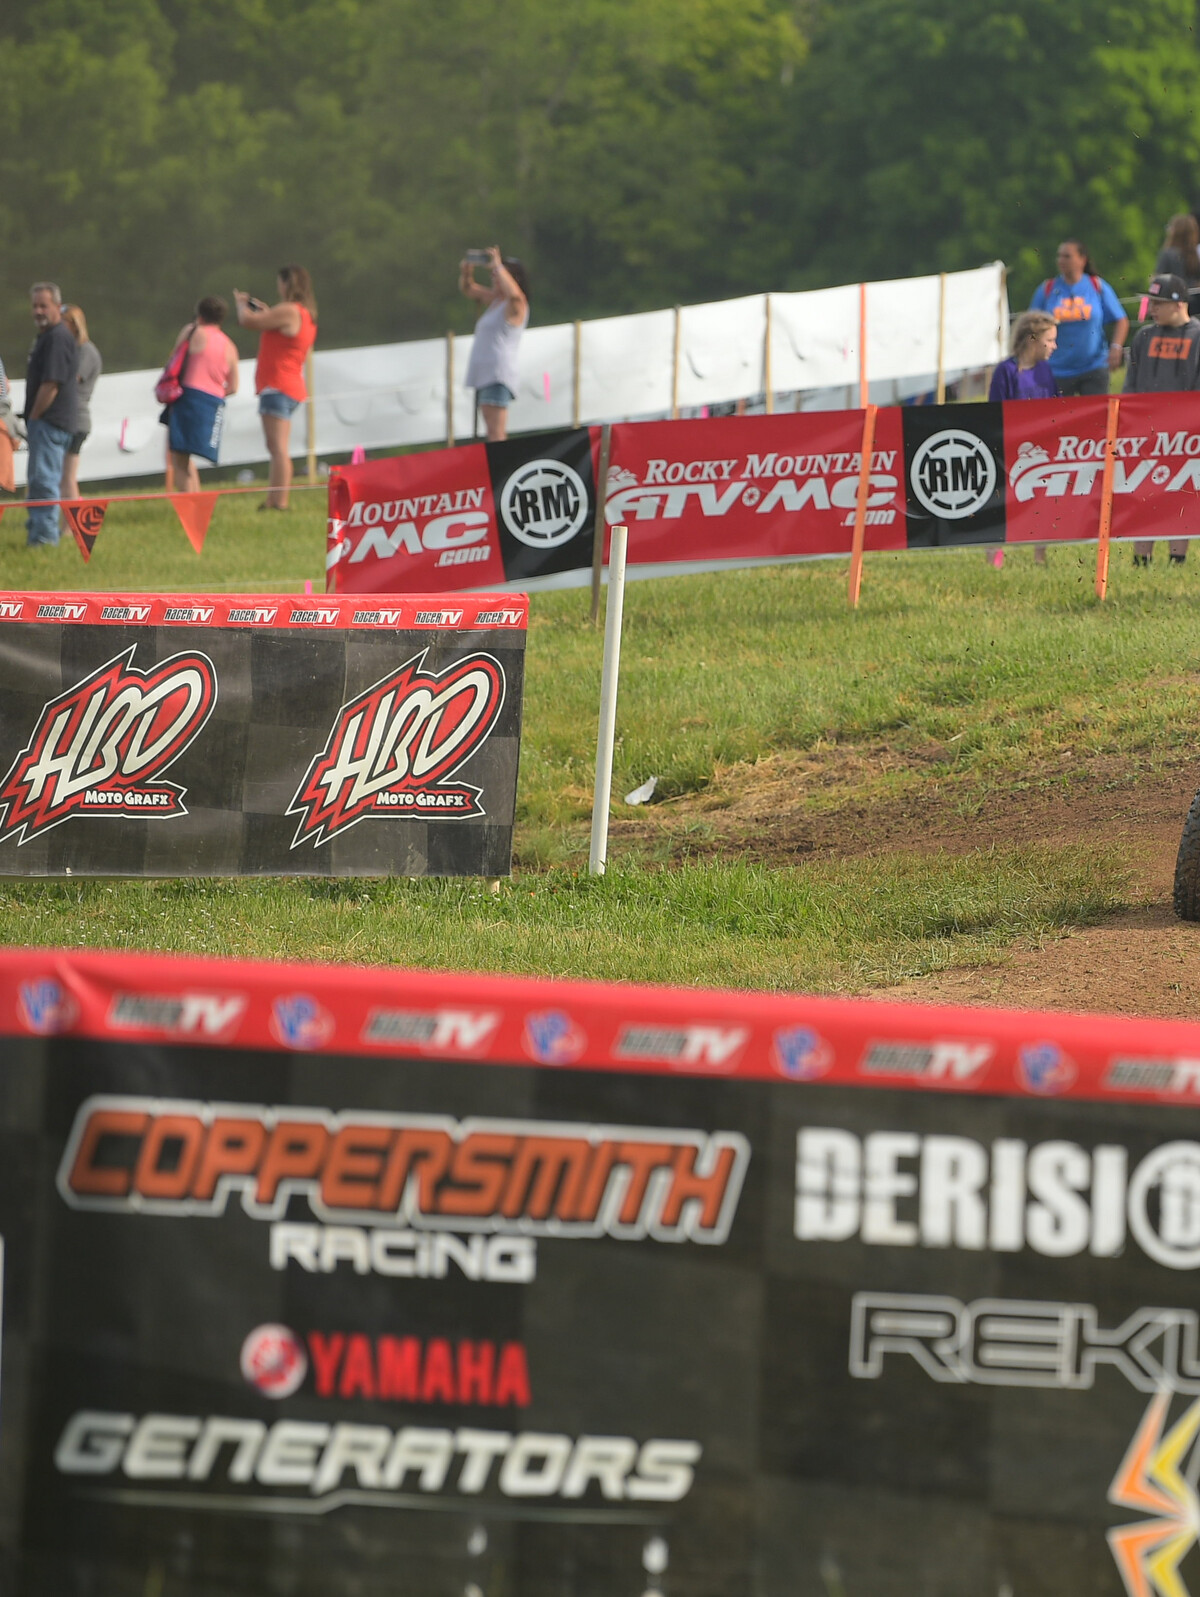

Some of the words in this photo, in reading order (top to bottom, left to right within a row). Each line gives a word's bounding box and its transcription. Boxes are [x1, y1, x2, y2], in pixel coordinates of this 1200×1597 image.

[643, 459, 738, 485] ROCKY
[928, 456, 978, 493] RM
[518, 483, 571, 524] RM
[85, 790, 124, 804] MOTO
[124, 791, 169, 806] GRAFX
[376, 792, 415, 806] MOTO
[415, 793, 464, 807] GRAFX
[57, 1094, 751, 1244] COPPERSMITH
[309, 1332, 531, 1407] YAMAHA
[55, 1412, 700, 1501] GENERATORS
